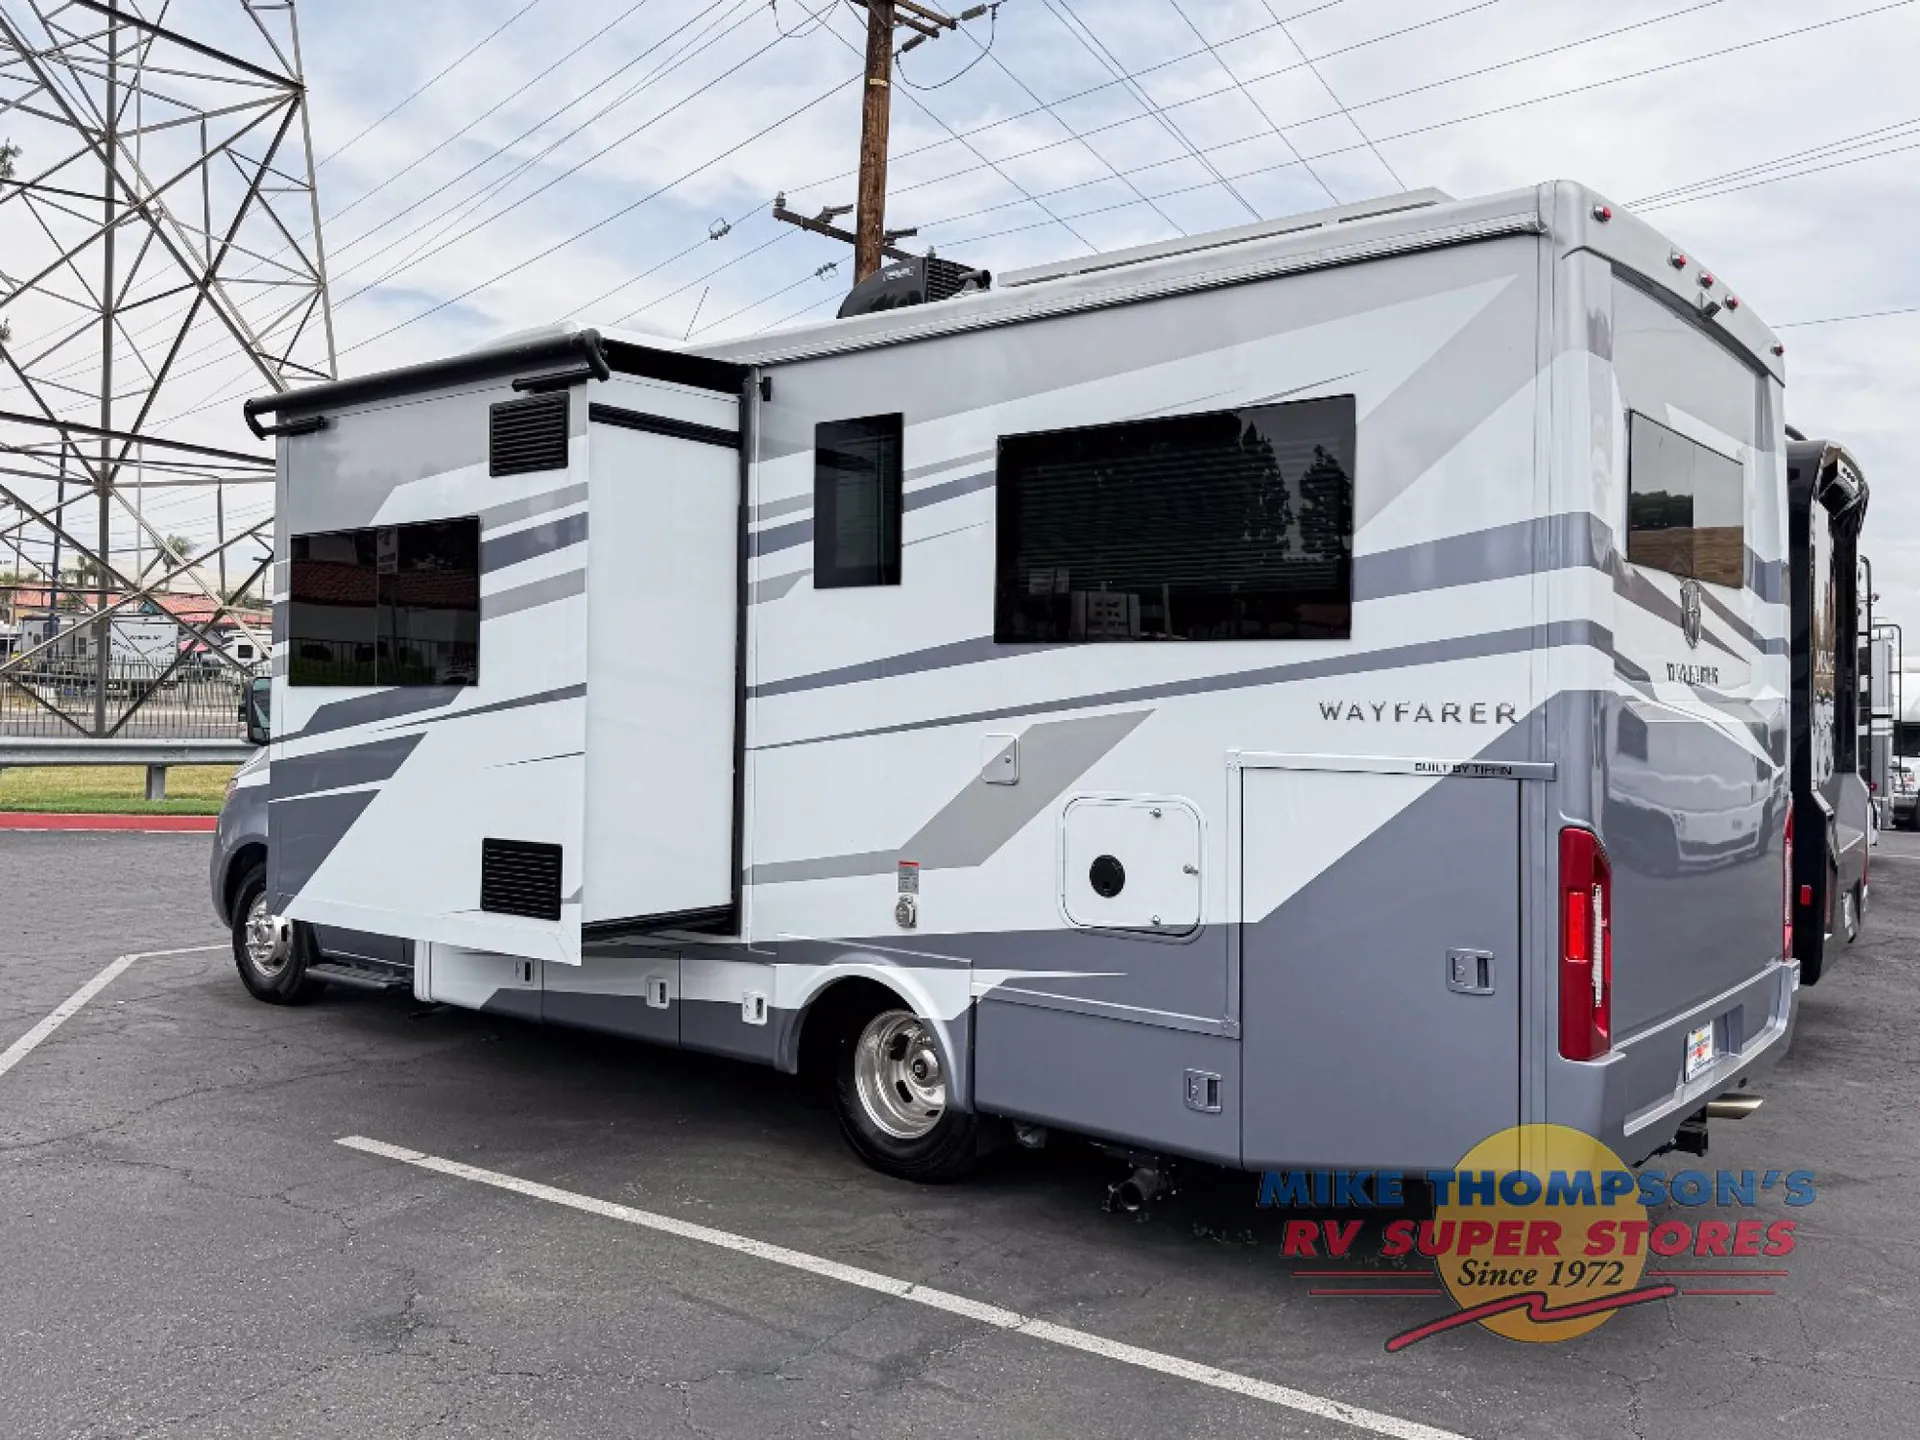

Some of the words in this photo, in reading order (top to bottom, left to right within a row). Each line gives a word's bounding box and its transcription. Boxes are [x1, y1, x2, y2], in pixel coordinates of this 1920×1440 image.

[1319, 700, 1518, 725] WAYFARER
[1414, 762, 1449, 773] BUILT
[1452, 764, 1469, 774] BY
